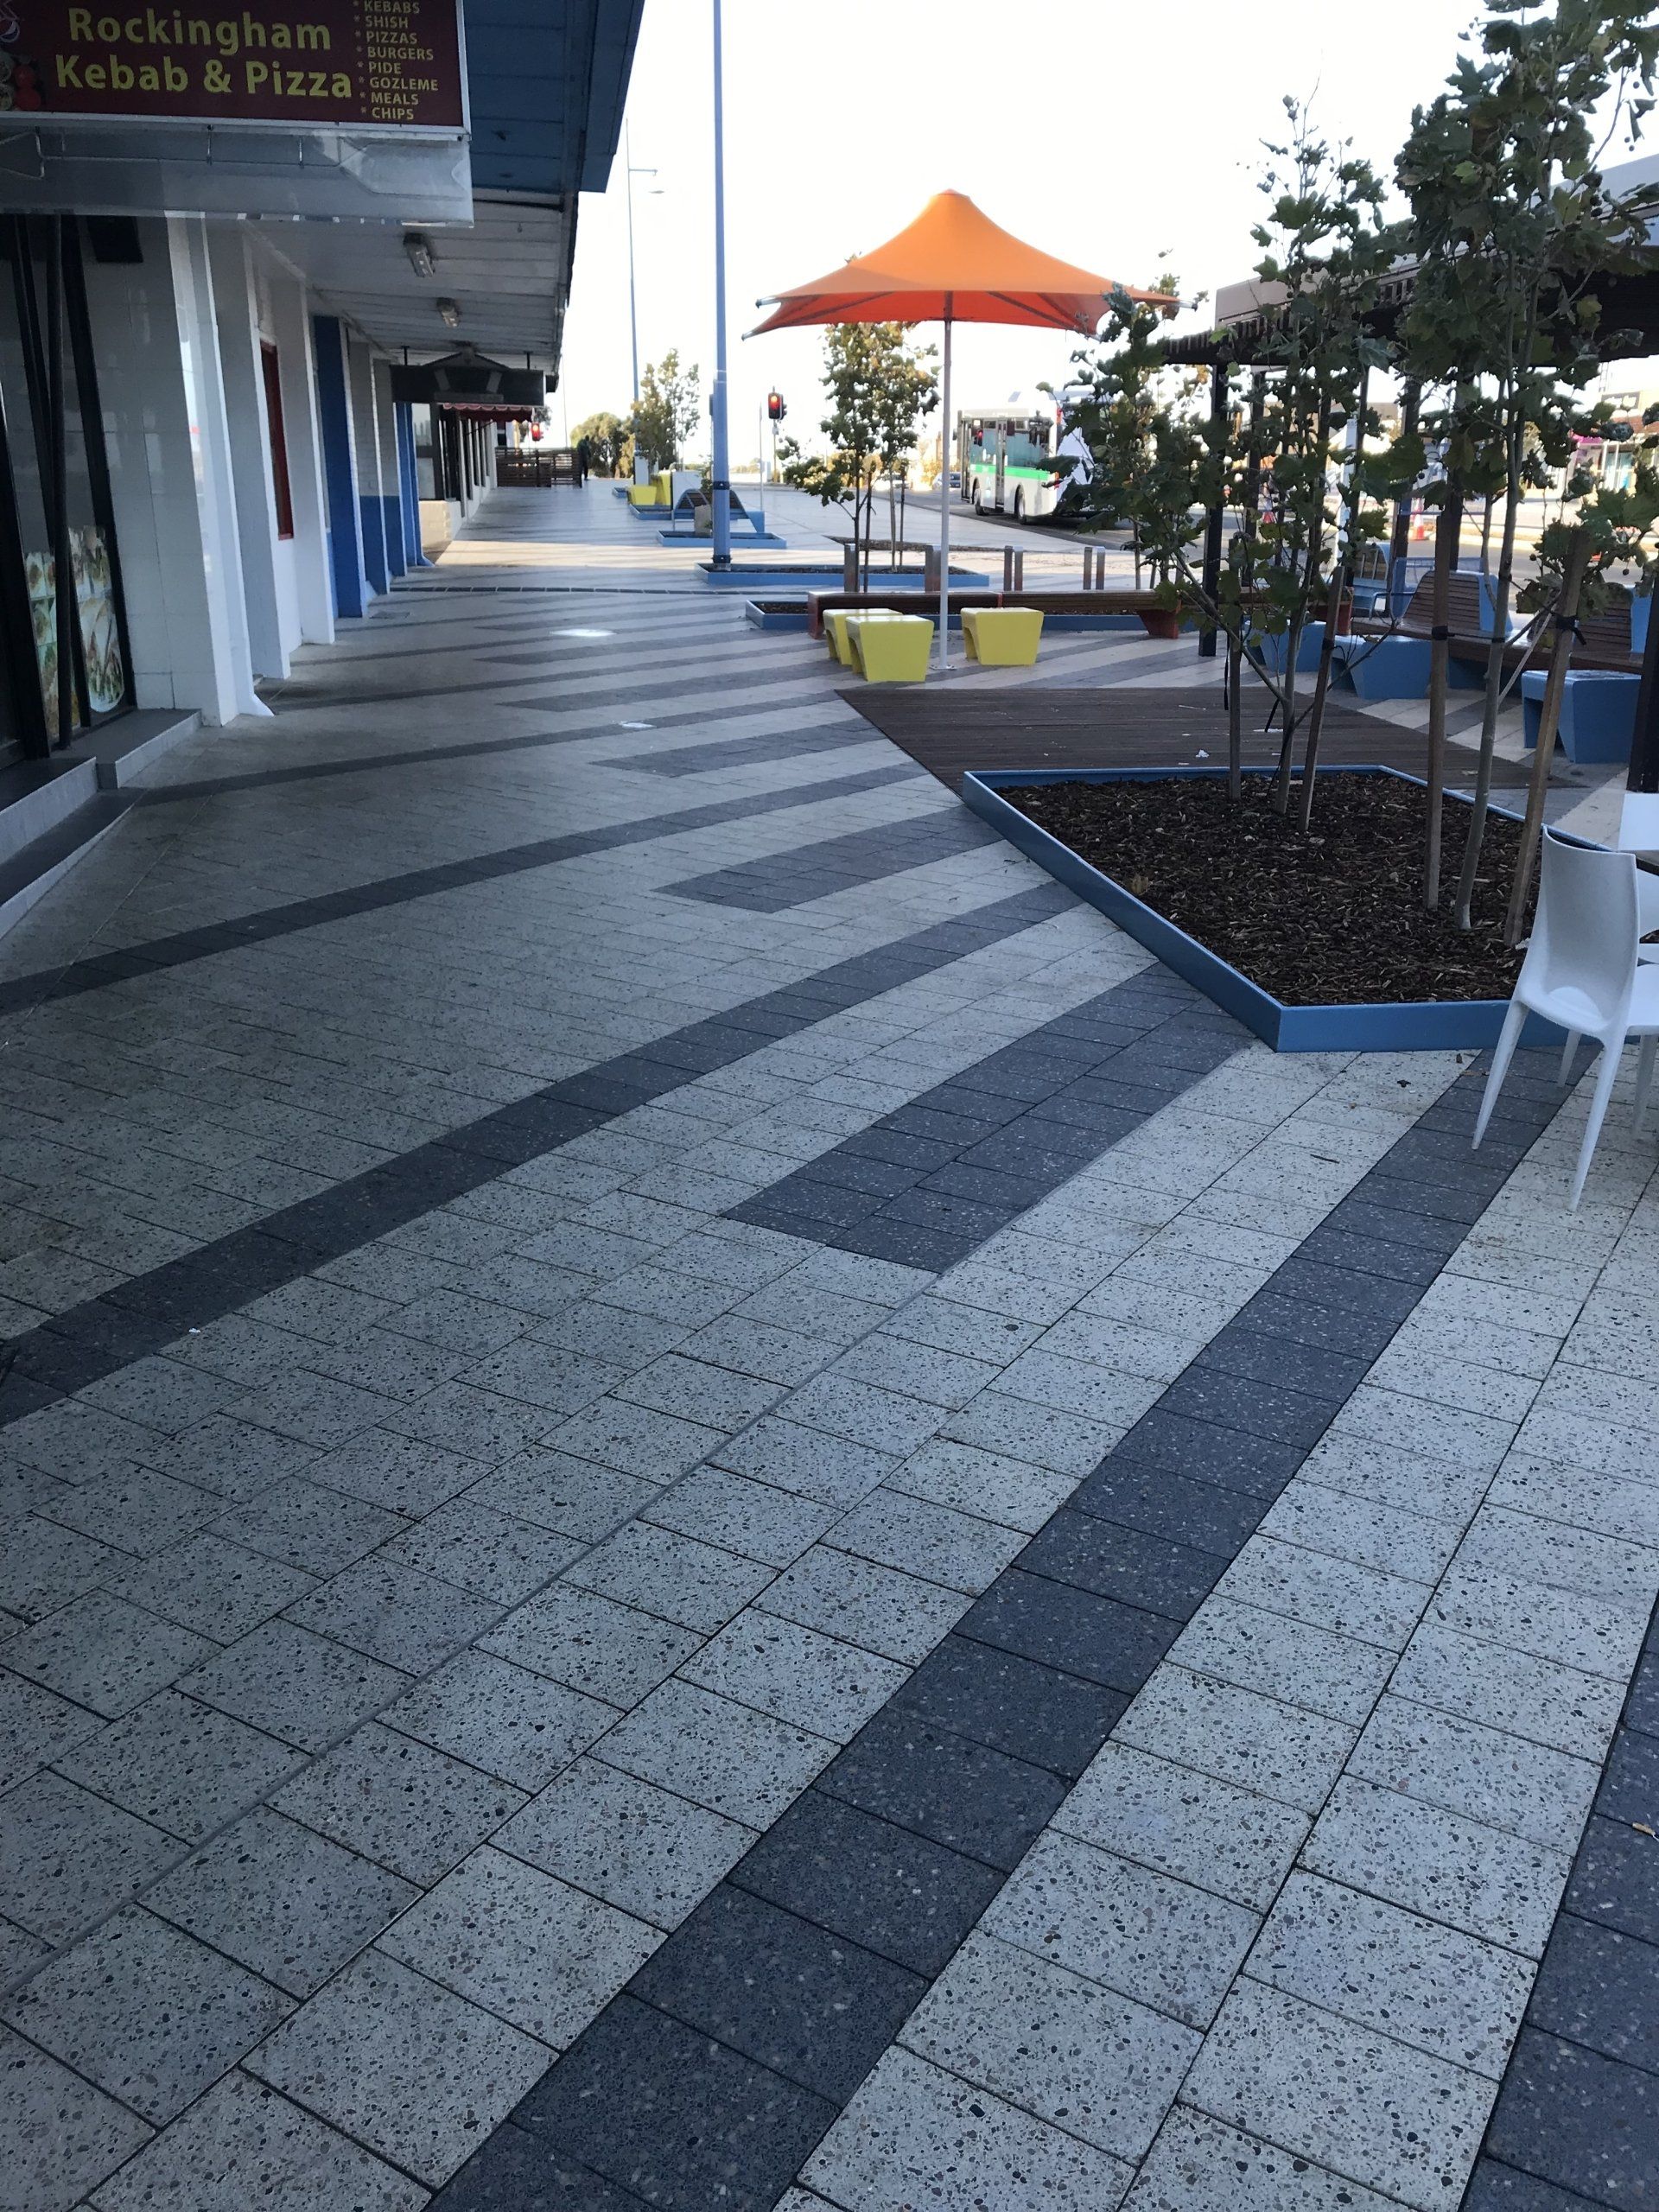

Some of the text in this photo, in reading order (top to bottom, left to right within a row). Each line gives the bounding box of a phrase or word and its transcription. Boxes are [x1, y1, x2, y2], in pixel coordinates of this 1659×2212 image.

[364, 0, 420, 14] KEBABS
[365, 16, 409, 29] SHISH
[68, 8, 331, 55] Rockingham
[365, 30, 418, 44] PIZZAS
[367, 47, 434, 60] BURGERS
[368, 62, 402, 74] PIDE
[55, 54, 352, 98] Kebab & Pizza
[370, 77, 439, 91] GOZLEME
[371, 92, 419, 105] MEALS
[372, 107, 414, 120] CHIPS
